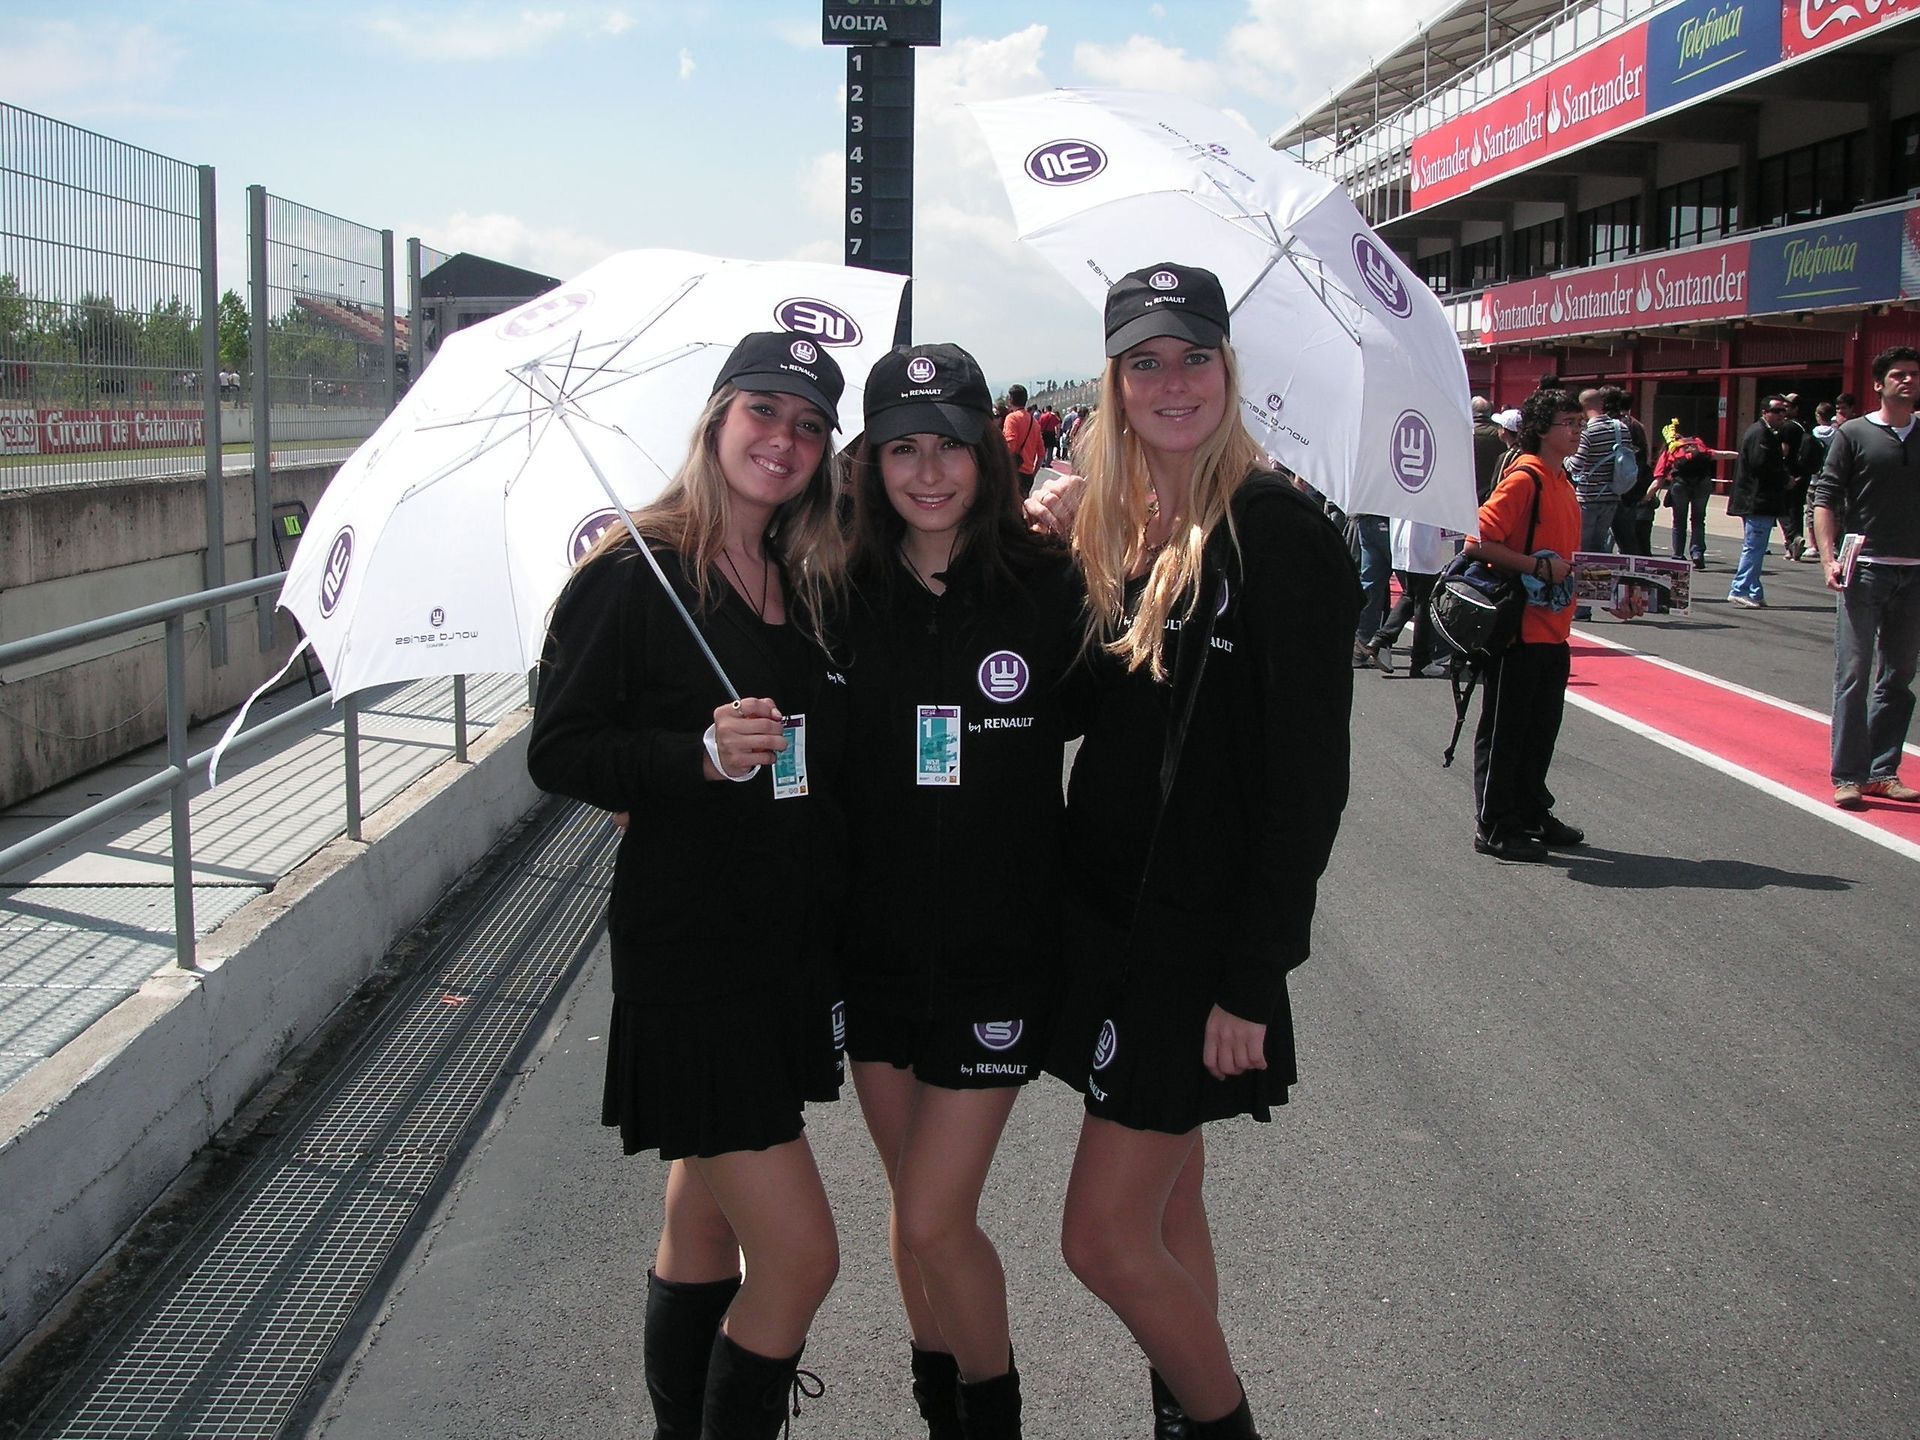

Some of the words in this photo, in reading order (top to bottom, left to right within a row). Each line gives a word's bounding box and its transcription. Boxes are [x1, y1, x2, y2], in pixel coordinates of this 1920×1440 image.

[828, 15, 888, 31] VOLTA
[852, 54, 862, 72] 1
[851, 85, 863, 102] 2
[851, 115, 863, 132] 3
[1420, 135, 1471, 191] Santander
[1482, 101, 1545, 164] Santander
[1562, 54, 1644, 129] Santander
[849, 146, 864, 163] 4
[850, 177, 863, 193] 5
[850, 207, 863, 224] 6
[849, 238, 862, 255] 7
[1153, 296, 1187, 304] RENAULT
[1492, 289, 1549, 332] Santander
[1564, 273, 1634, 321] Santander
[1655, 253, 1746, 311] Santander
[789, 363, 818, 381] RENAULT
[909, 388, 942, 397] RENAULT
[47, 411, 103, 447] Circuit
[111, 411, 129, 444] de
[135, 410, 203, 446] Catalunya
[922, 718, 933, 738] 1
[968, 721, 981, 733] by
[983, 717, 1034, 729] RENAULT
[960, 1062, 973, 1076] by
[976, 1062, 1027, 1075] RENAULT
